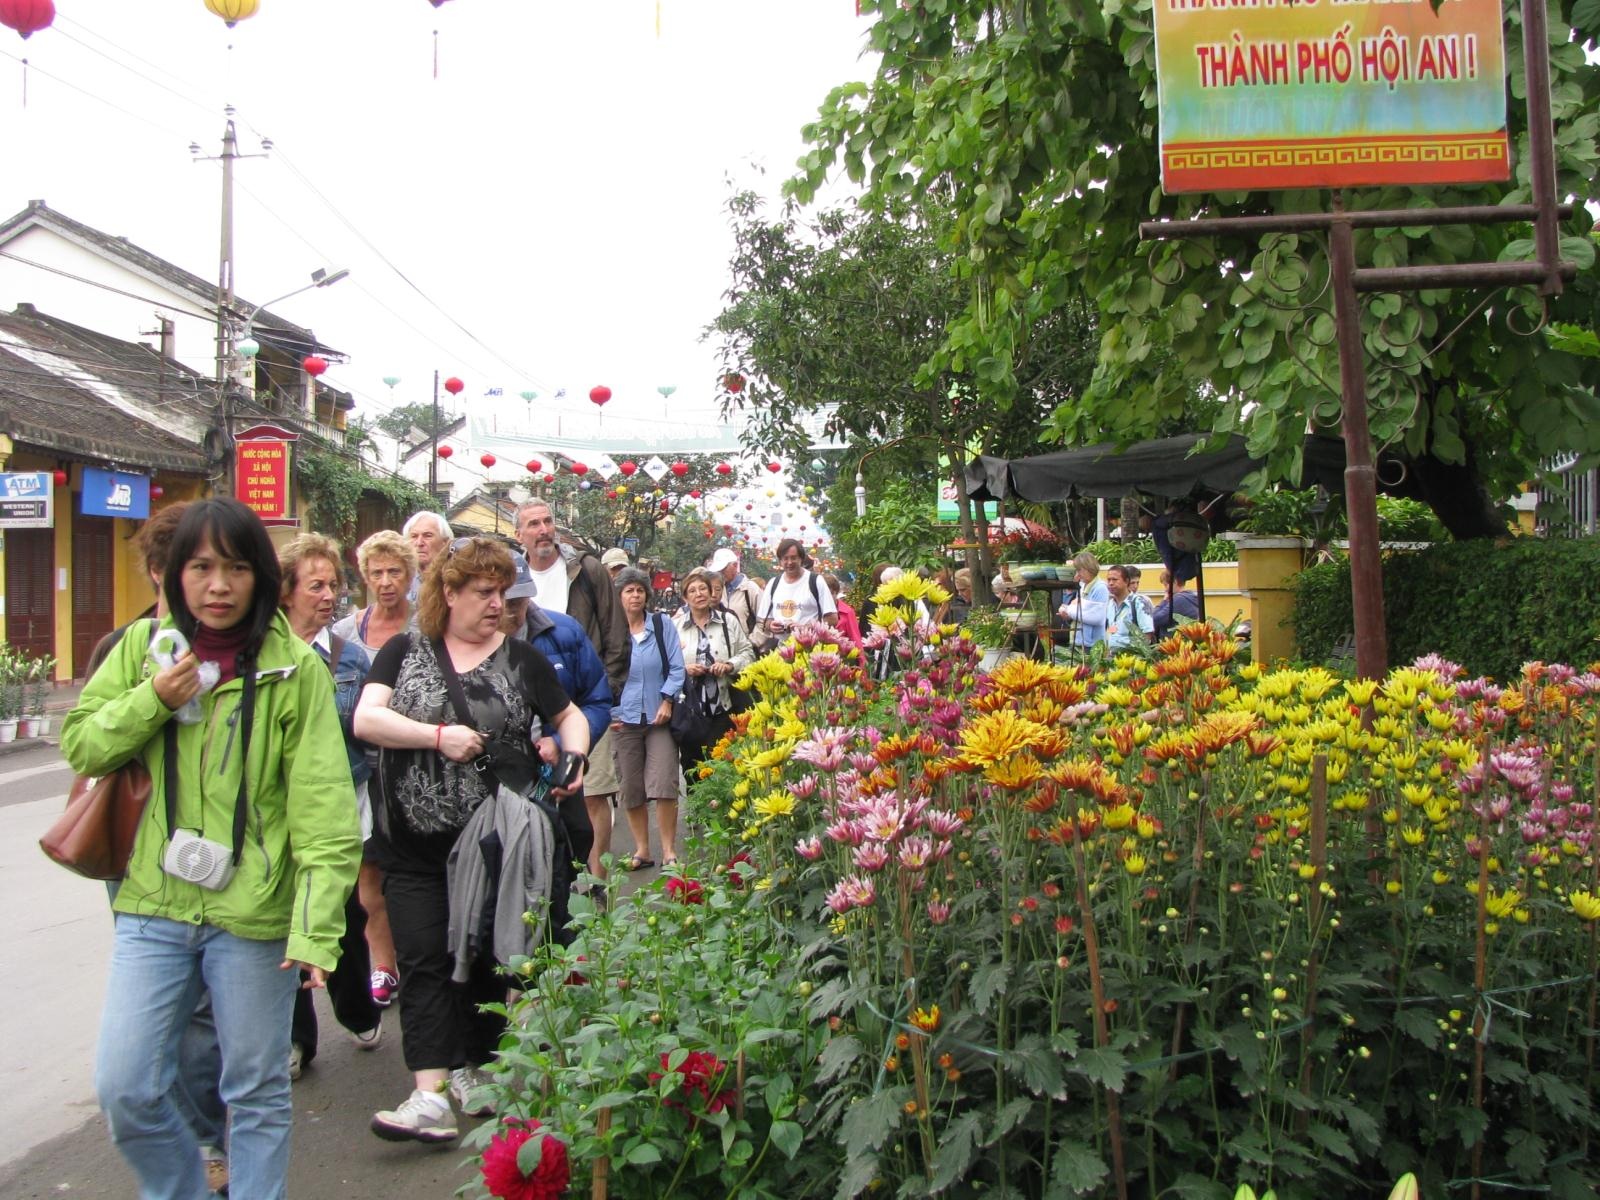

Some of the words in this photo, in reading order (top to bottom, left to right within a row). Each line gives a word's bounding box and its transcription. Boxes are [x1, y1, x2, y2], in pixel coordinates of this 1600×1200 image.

[1197, 33, 1289, 88] THÀNH
[1297, 24, 1352, 85] PHỐ
[1361, 29, 1409, 91] HỘI
[1418, 38, 1458, 81] AN
[257, 448, 270, 459] CỘNG
[253, 462, 260, 472] XÃ
[261, 462, 272, 473] HỘI
[10, 478, 38, 488] ATM
[247, 474, 259, 485] CHỦ
[259, 475, 276, 485] NGHĨA
[249, 488, 261, 499] VIỆT
[262, 489, 275, 499] NAM
[262, 501, 275, 512] NĂM
